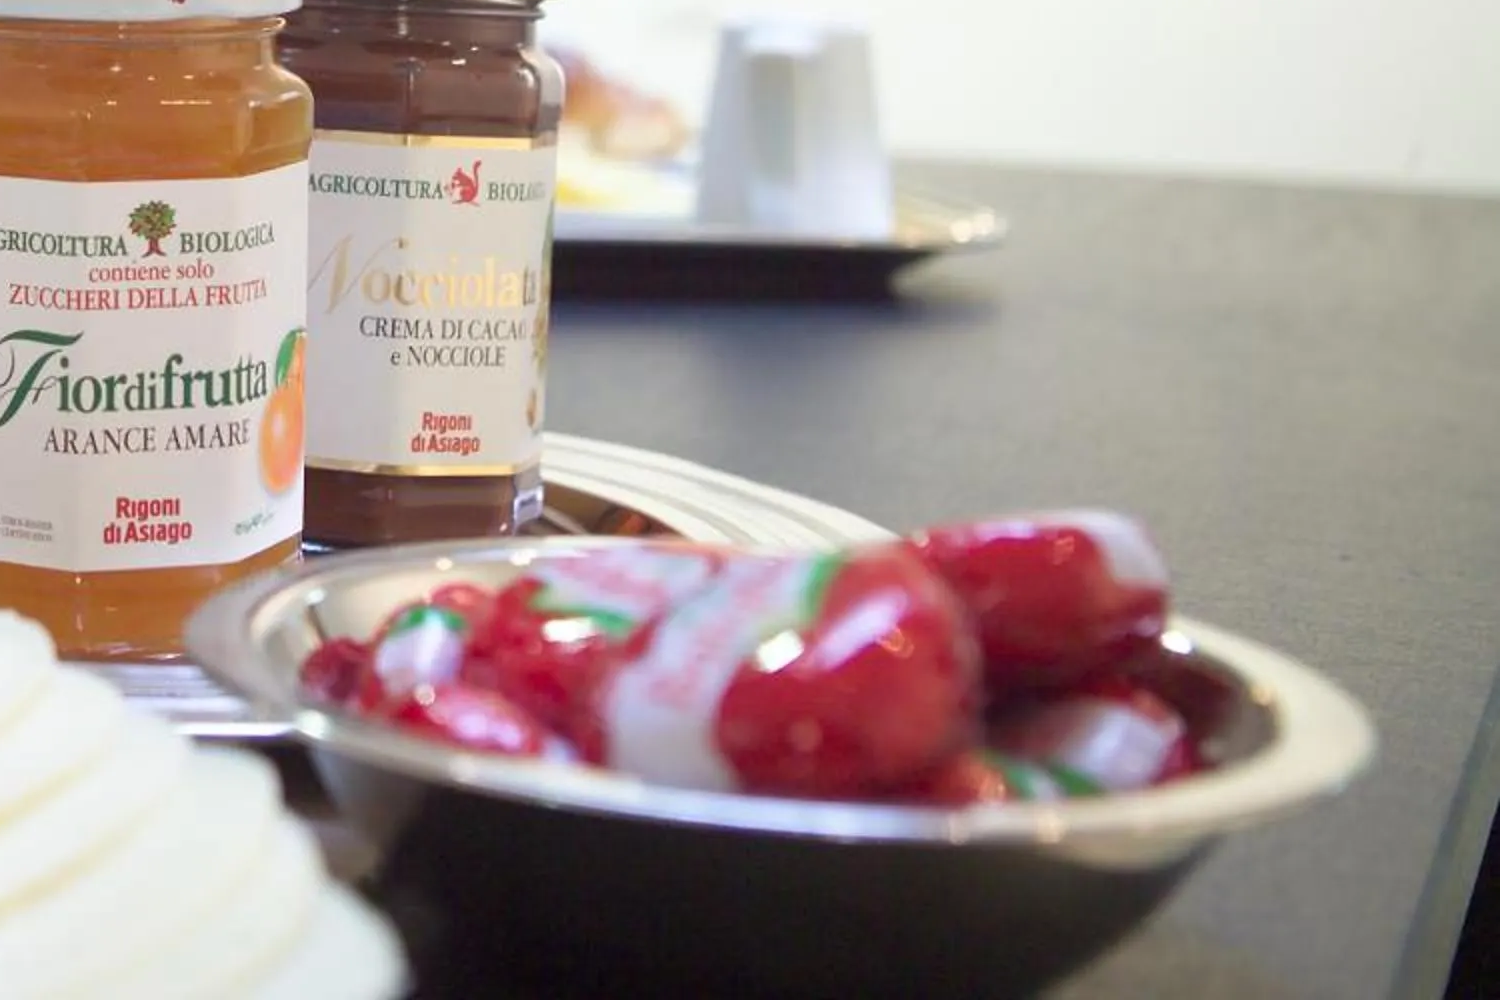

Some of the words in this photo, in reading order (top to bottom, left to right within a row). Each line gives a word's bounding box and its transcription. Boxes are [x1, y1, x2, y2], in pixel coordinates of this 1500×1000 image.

[308, 172, 444, 200] AGRICOLTURA
[180, 222, 276, 254] BIOLOGICA
[89, 261, 171, 283] contiene
[176, 258, 215, 281] solo
[8, 283, 121, 311] ZUCCHERI
[127, 285, 198, 309] DELLA
[204, 279, 268, 307] FRUTTA
[360, 315, 434, 340] CREMA
[441, 318, 463, 340] DI
[390, 352, 401, 367] e
[407, 345, 506, 368] NOCCIOLE
[422, 411, 472, 433] Rigoni
[44, 426, 156, 454] ARANCE
[164, 419, 251, 453] AMARE
[411, 434, 426, 453] di
[427, 434, 480, 456] Asiago
[116, 497, 180, 522] Rigoni
[103, 522, 122, 544] di
[124, 521, 193, 543] Asiago
